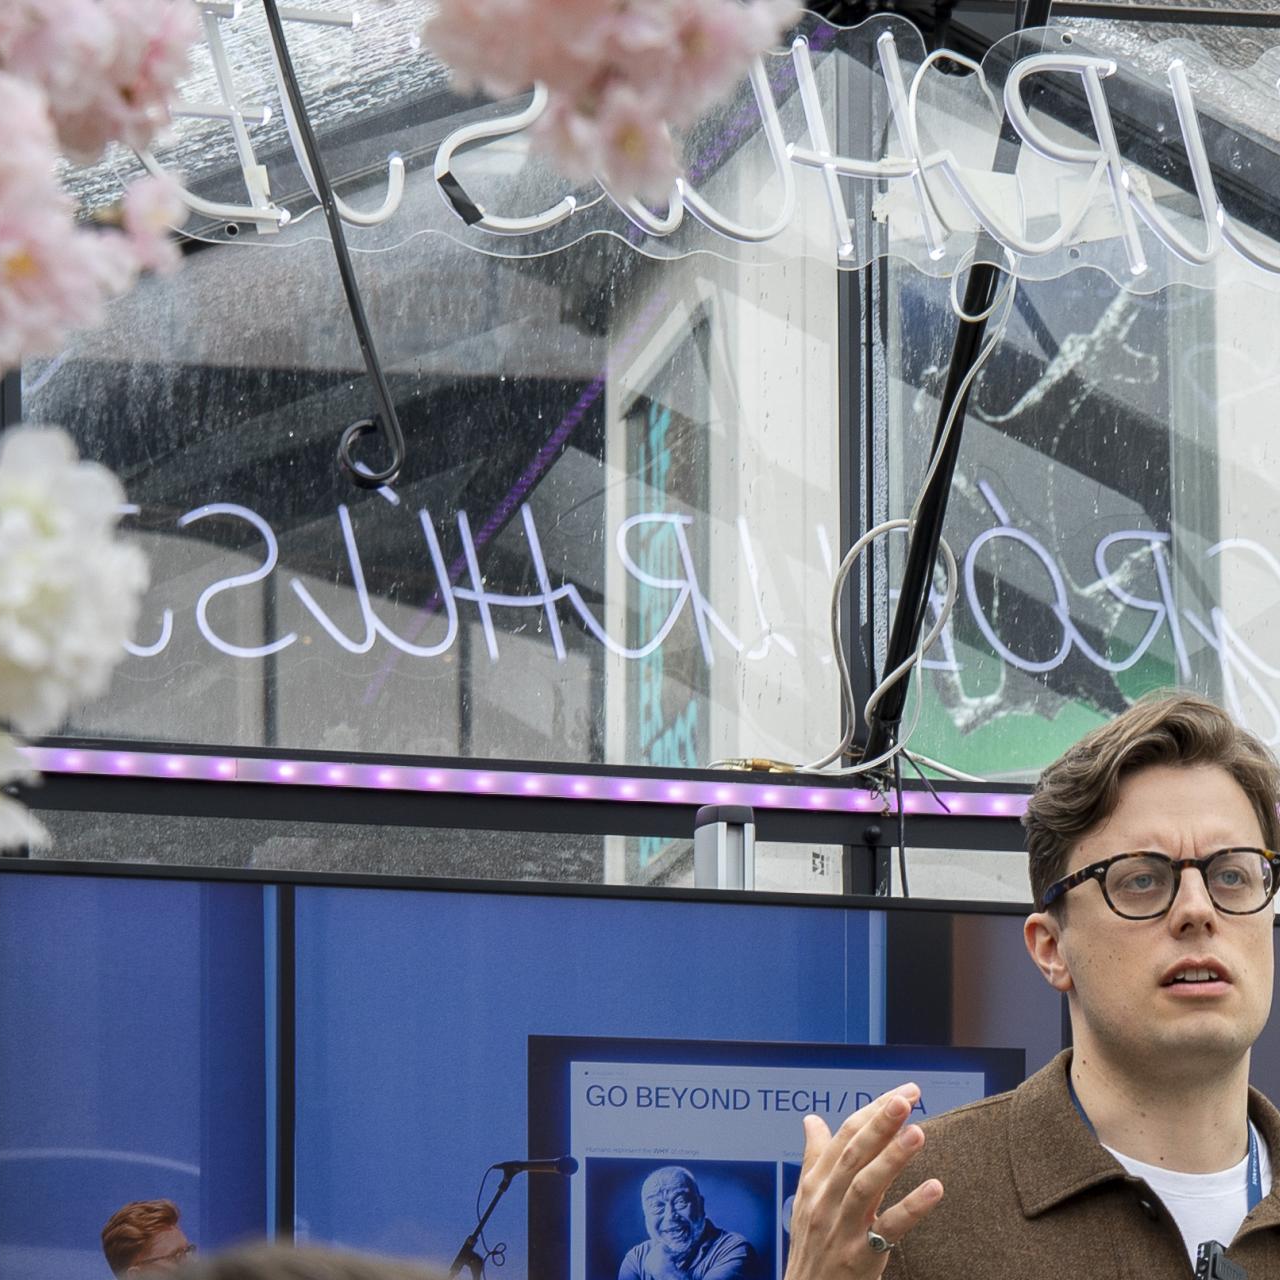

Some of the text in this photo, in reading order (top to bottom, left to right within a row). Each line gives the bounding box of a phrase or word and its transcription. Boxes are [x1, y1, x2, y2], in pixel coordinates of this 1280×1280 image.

[586, 1084, 927, 1115] GO BEYOND TECH / DA
